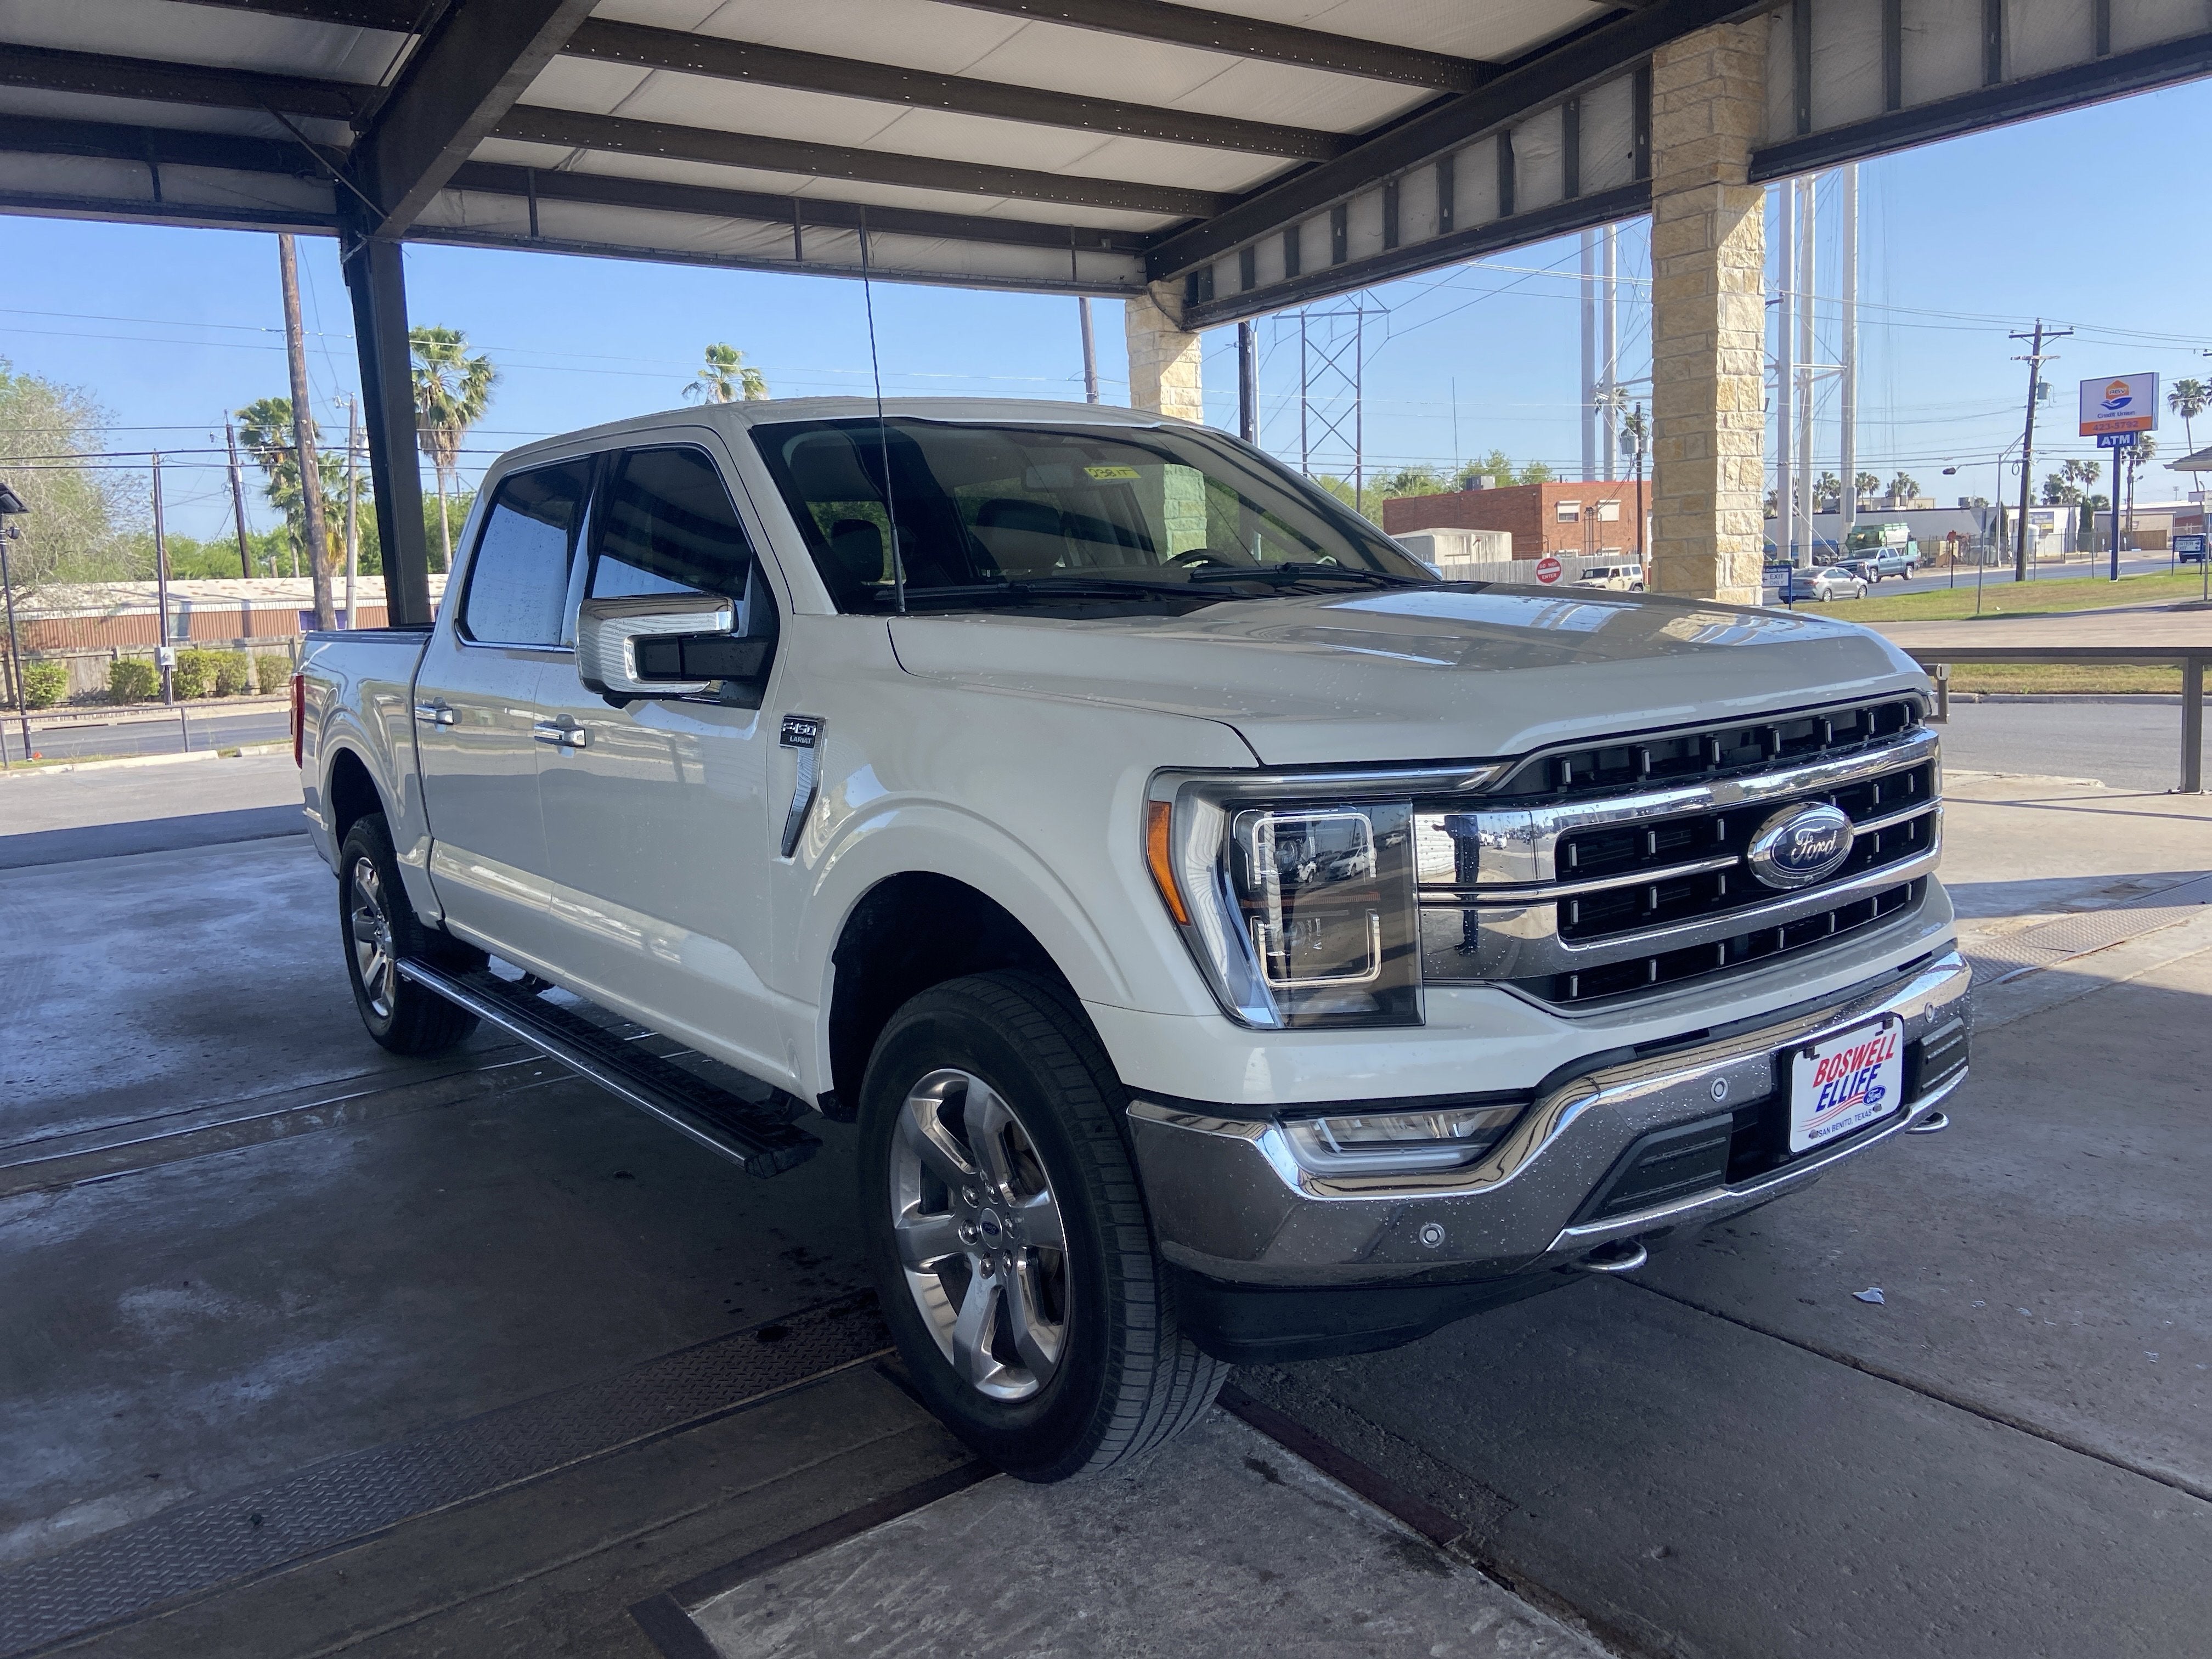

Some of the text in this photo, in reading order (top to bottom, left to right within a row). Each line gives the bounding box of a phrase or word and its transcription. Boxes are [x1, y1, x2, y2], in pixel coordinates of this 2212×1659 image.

[2093, 421, 2138, 431] 423-5792
[2101, 434, 2130, 446] ATM
[782, 721, 817, 736] F-150
[789, 736, 812, 744] LARIAT
[1790, 825, 1837, 865] Ford
[1812, 1032, 1897, 1088] BOSWELL
[1815, 1063, 1882, 1113] ELLIFF
[1818, 1108, 1872, 1137] SAN BENITO, TEXAS
